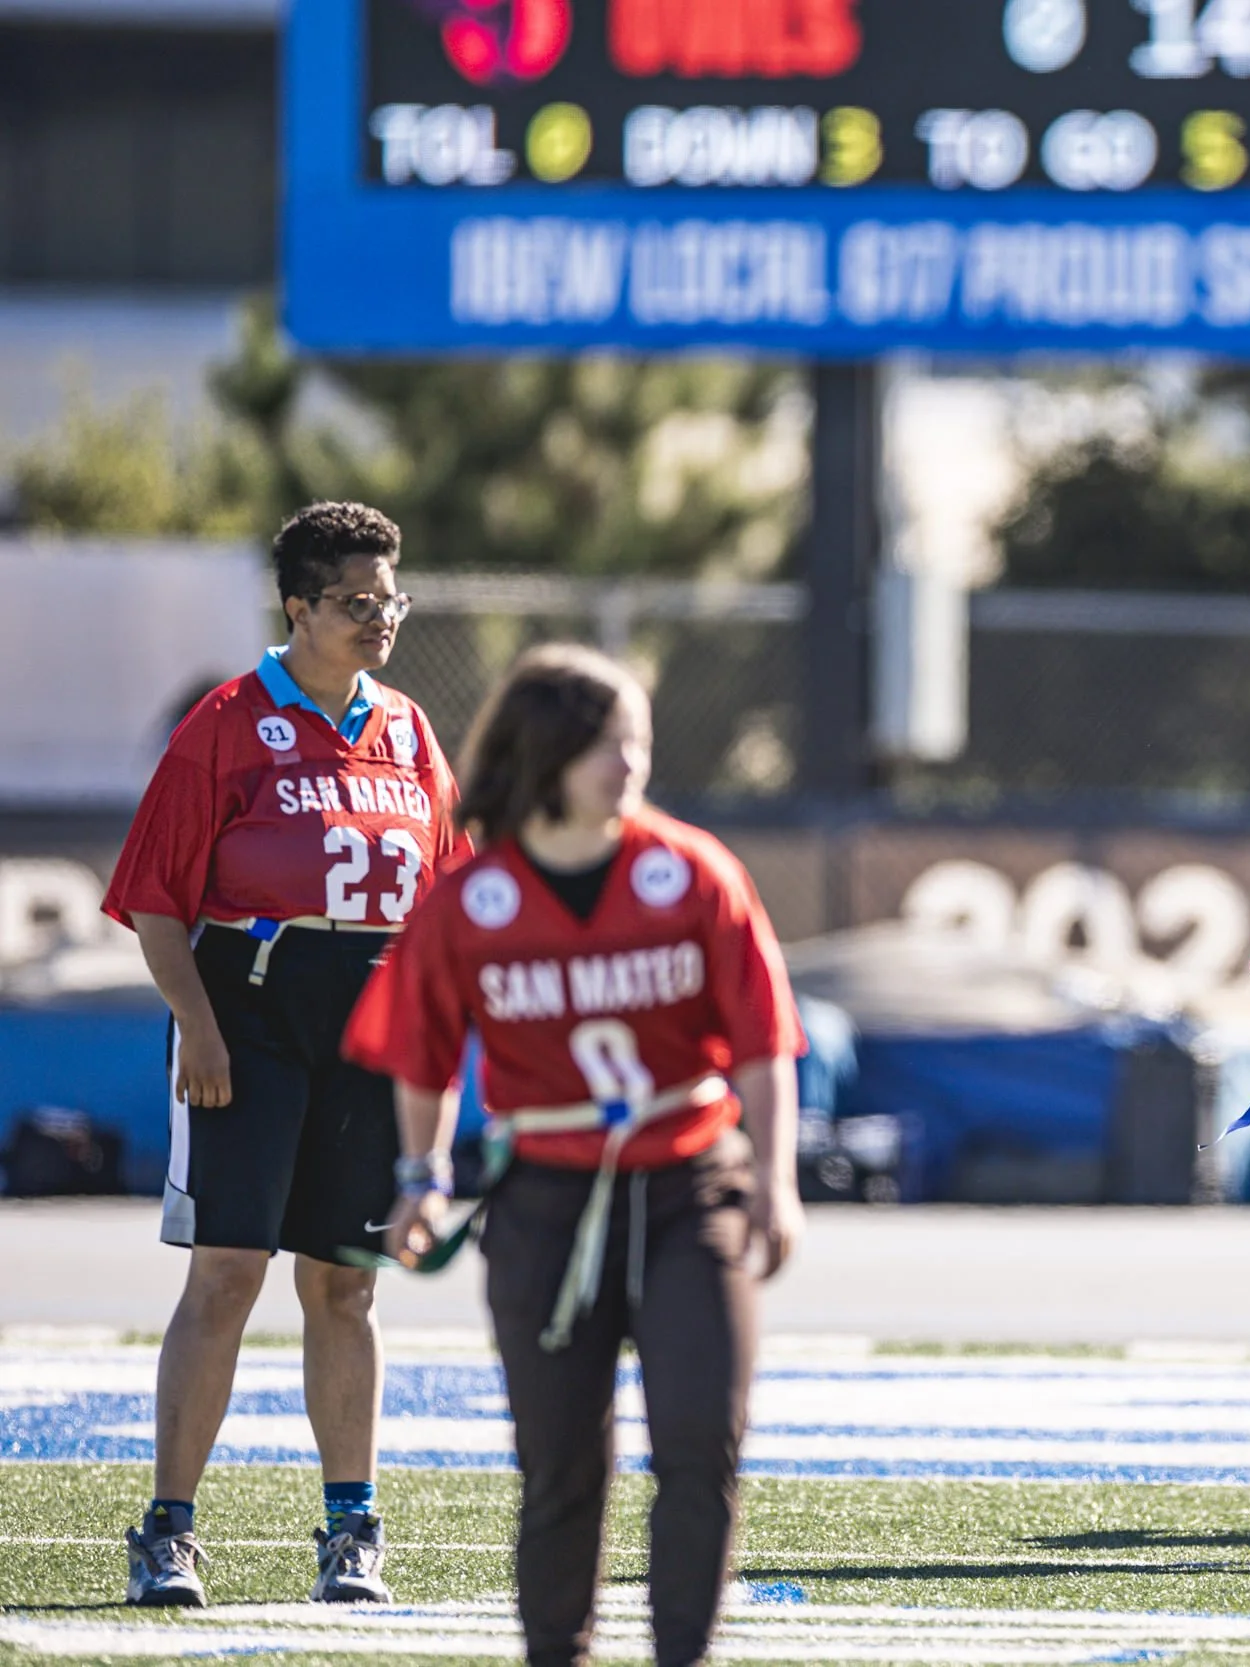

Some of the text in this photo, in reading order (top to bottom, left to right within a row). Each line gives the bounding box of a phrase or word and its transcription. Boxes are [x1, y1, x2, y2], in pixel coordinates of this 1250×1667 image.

[370, 103, 517, 186] TOL
[623, 104, 884, 187] DOWN 3
[915, 107, 1029, 190] TO
[1041, 109, 1159, 191] GO
[629, 219, 831, 327] LOCAL
[962, 221, 1196, 328] PROUD
[261, 725, 290, 742] 21
[276, 776, 432, 826] SAN MATEO
[323, 826, 422, 921] 23
[478, 940, 705, 1022] SAN MATEO
